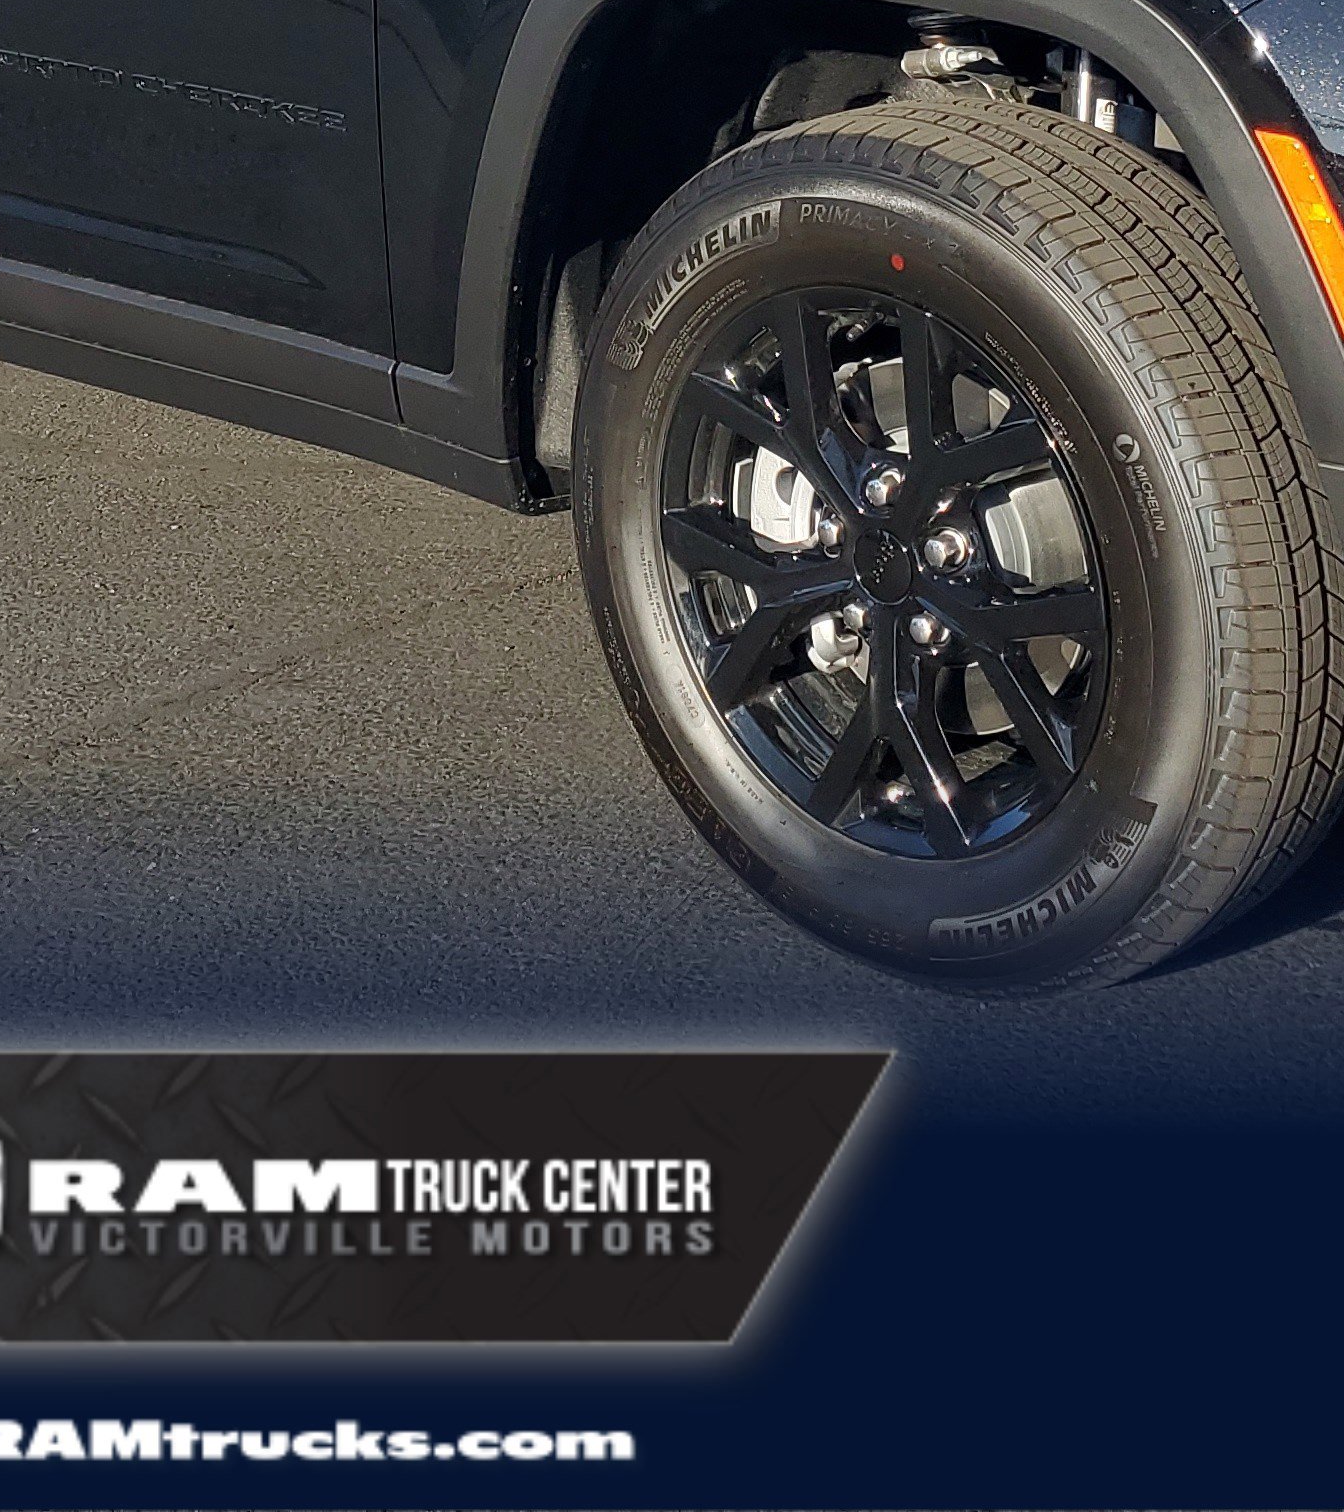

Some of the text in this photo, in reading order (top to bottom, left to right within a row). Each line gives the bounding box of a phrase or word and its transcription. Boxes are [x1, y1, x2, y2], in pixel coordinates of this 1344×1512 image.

[642, 207, 772, 320] MICHELIN
[1133, 464, 1167, 532] MICHELIN
[936, 864, 1099, 946] MICHELIN
